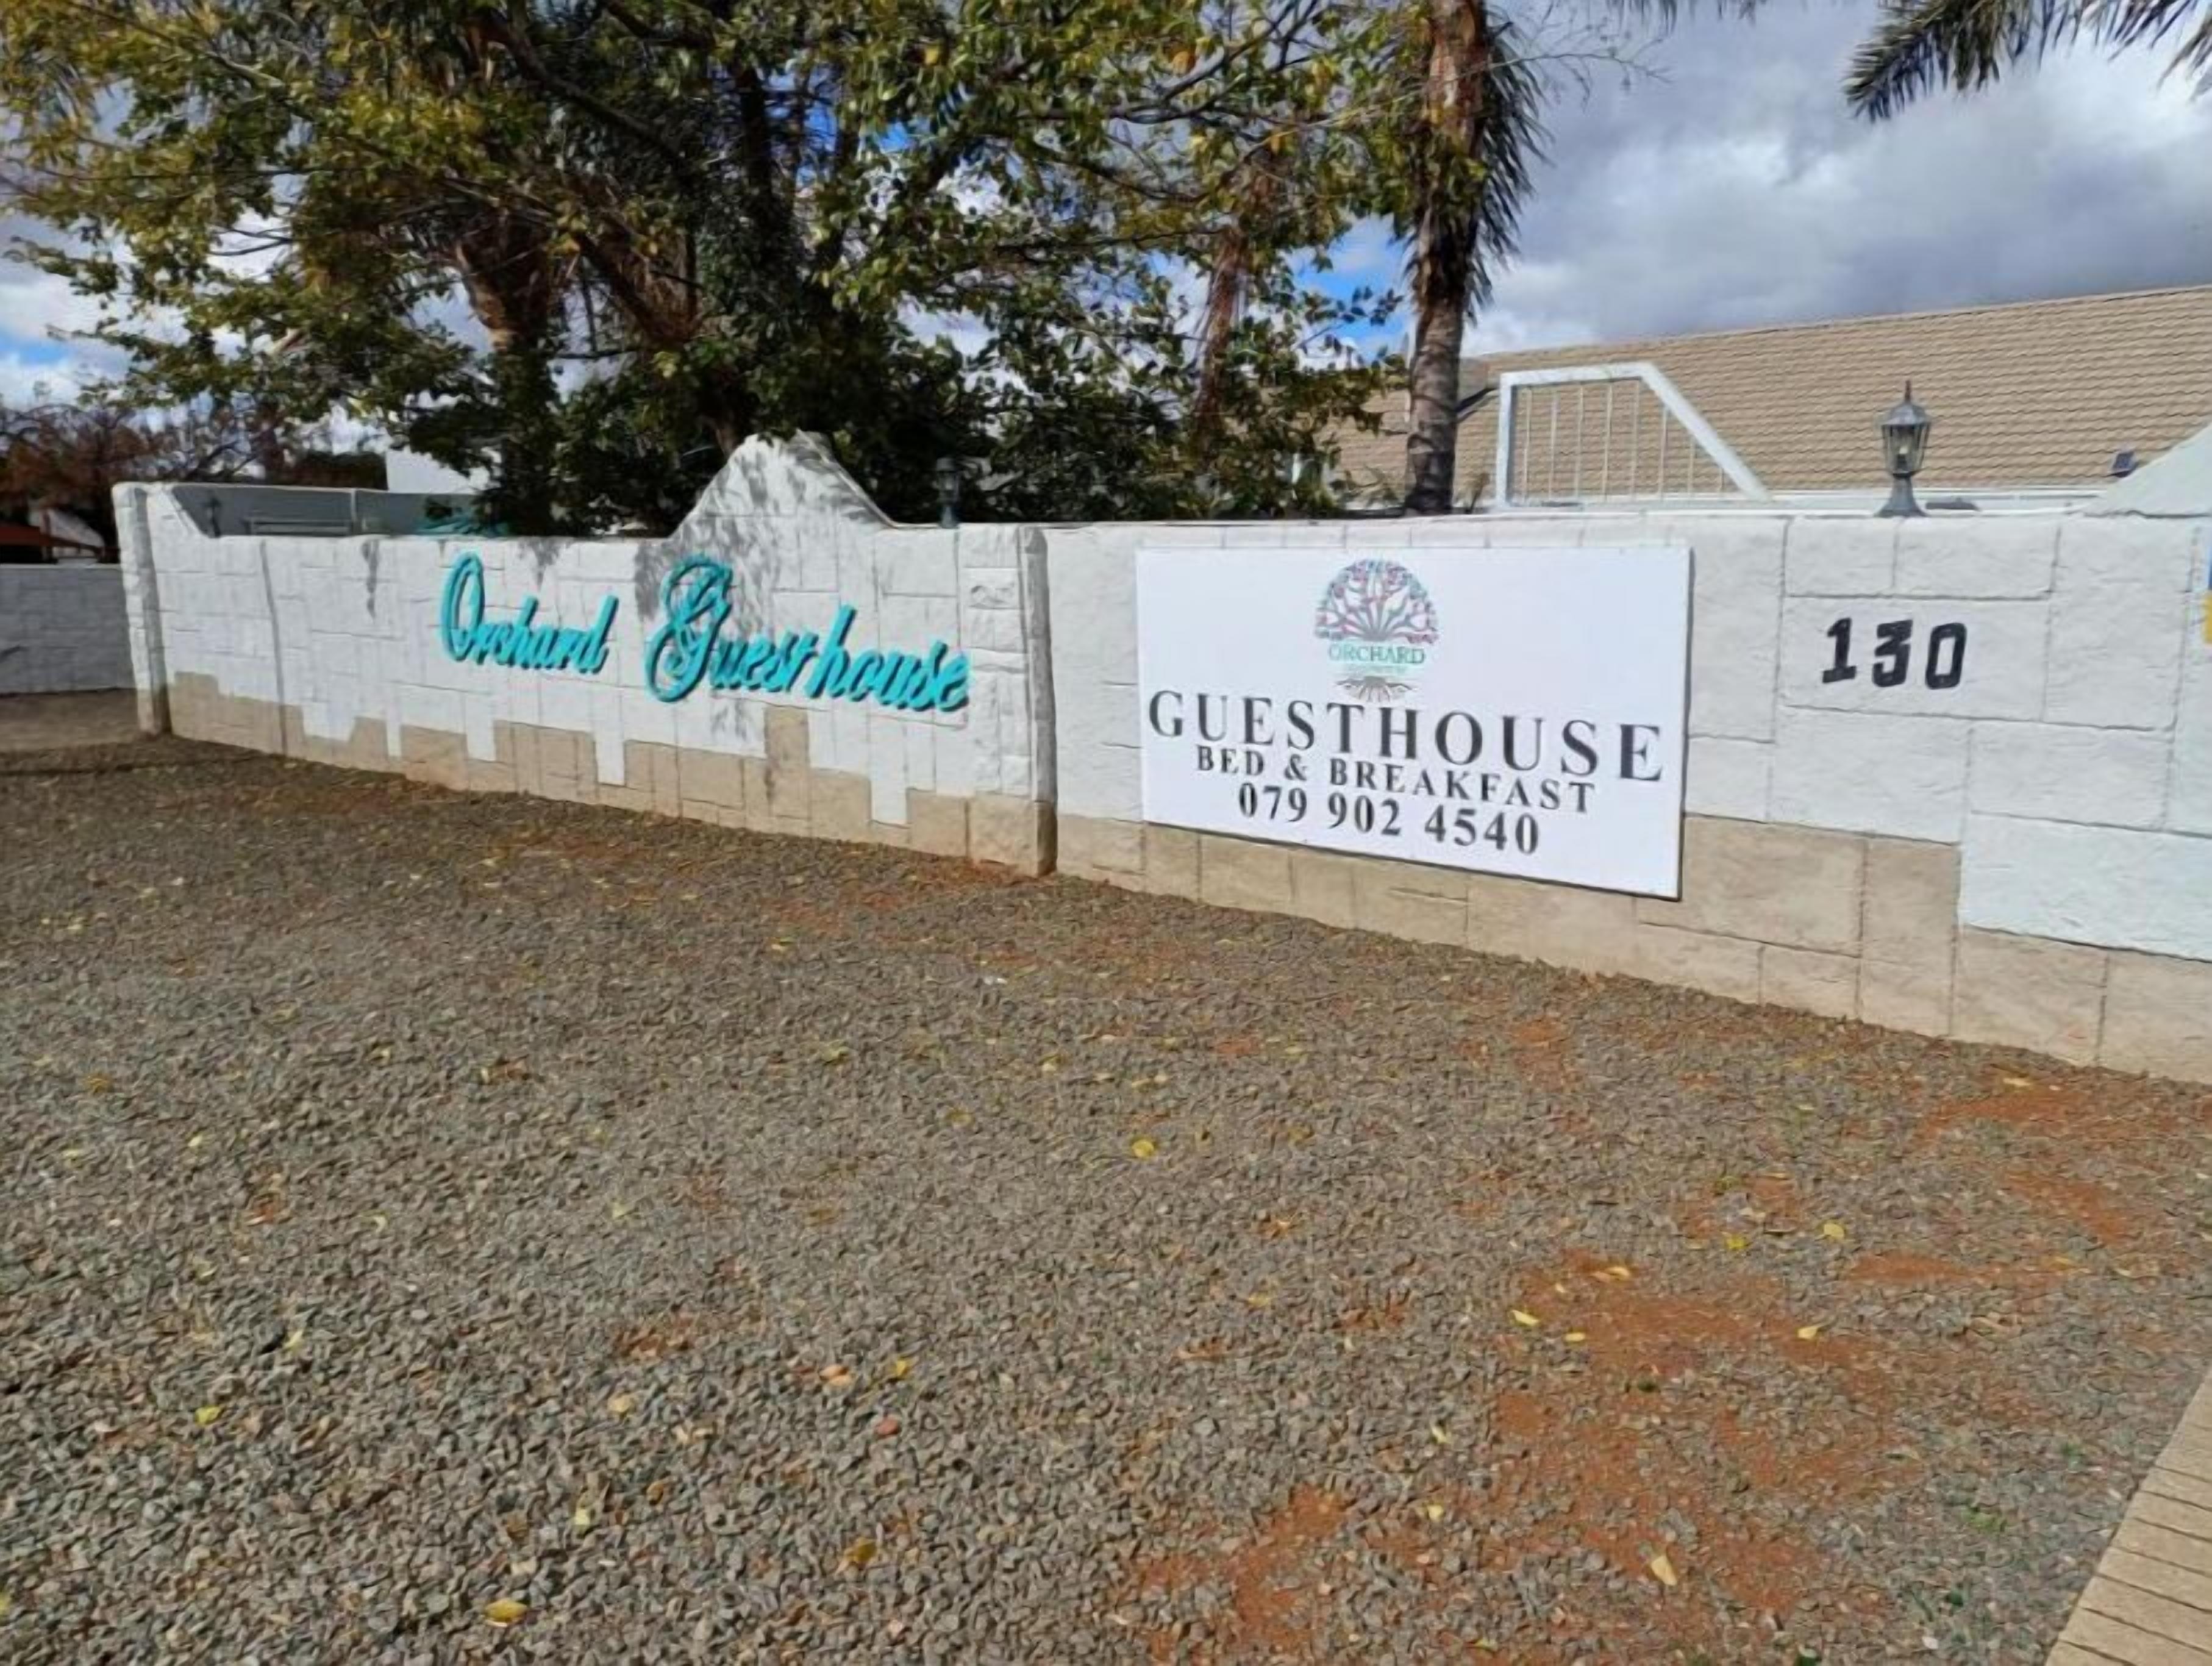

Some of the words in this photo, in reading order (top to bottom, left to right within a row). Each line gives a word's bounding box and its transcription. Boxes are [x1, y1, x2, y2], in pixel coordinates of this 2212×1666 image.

[441, 549, 618, 674] Orchard
[644, 552, 970, 712] Guesthouse
[1329, 643, 1425, 664] ORCHARD
[1822, 617, 1968, 690] 130
[1149, 690, 1663, 782] GUESTHOUSE
[1196, 744, 1265, 776] BED
[1283, 754, 1308, 782] &
[1329, 759, 1596, 813] BREAKFAST
[1238, 782, 1308, 822] 079
[1327, 793, 1403, 837] 902
[1425, 806, 1540, 854] 4540
